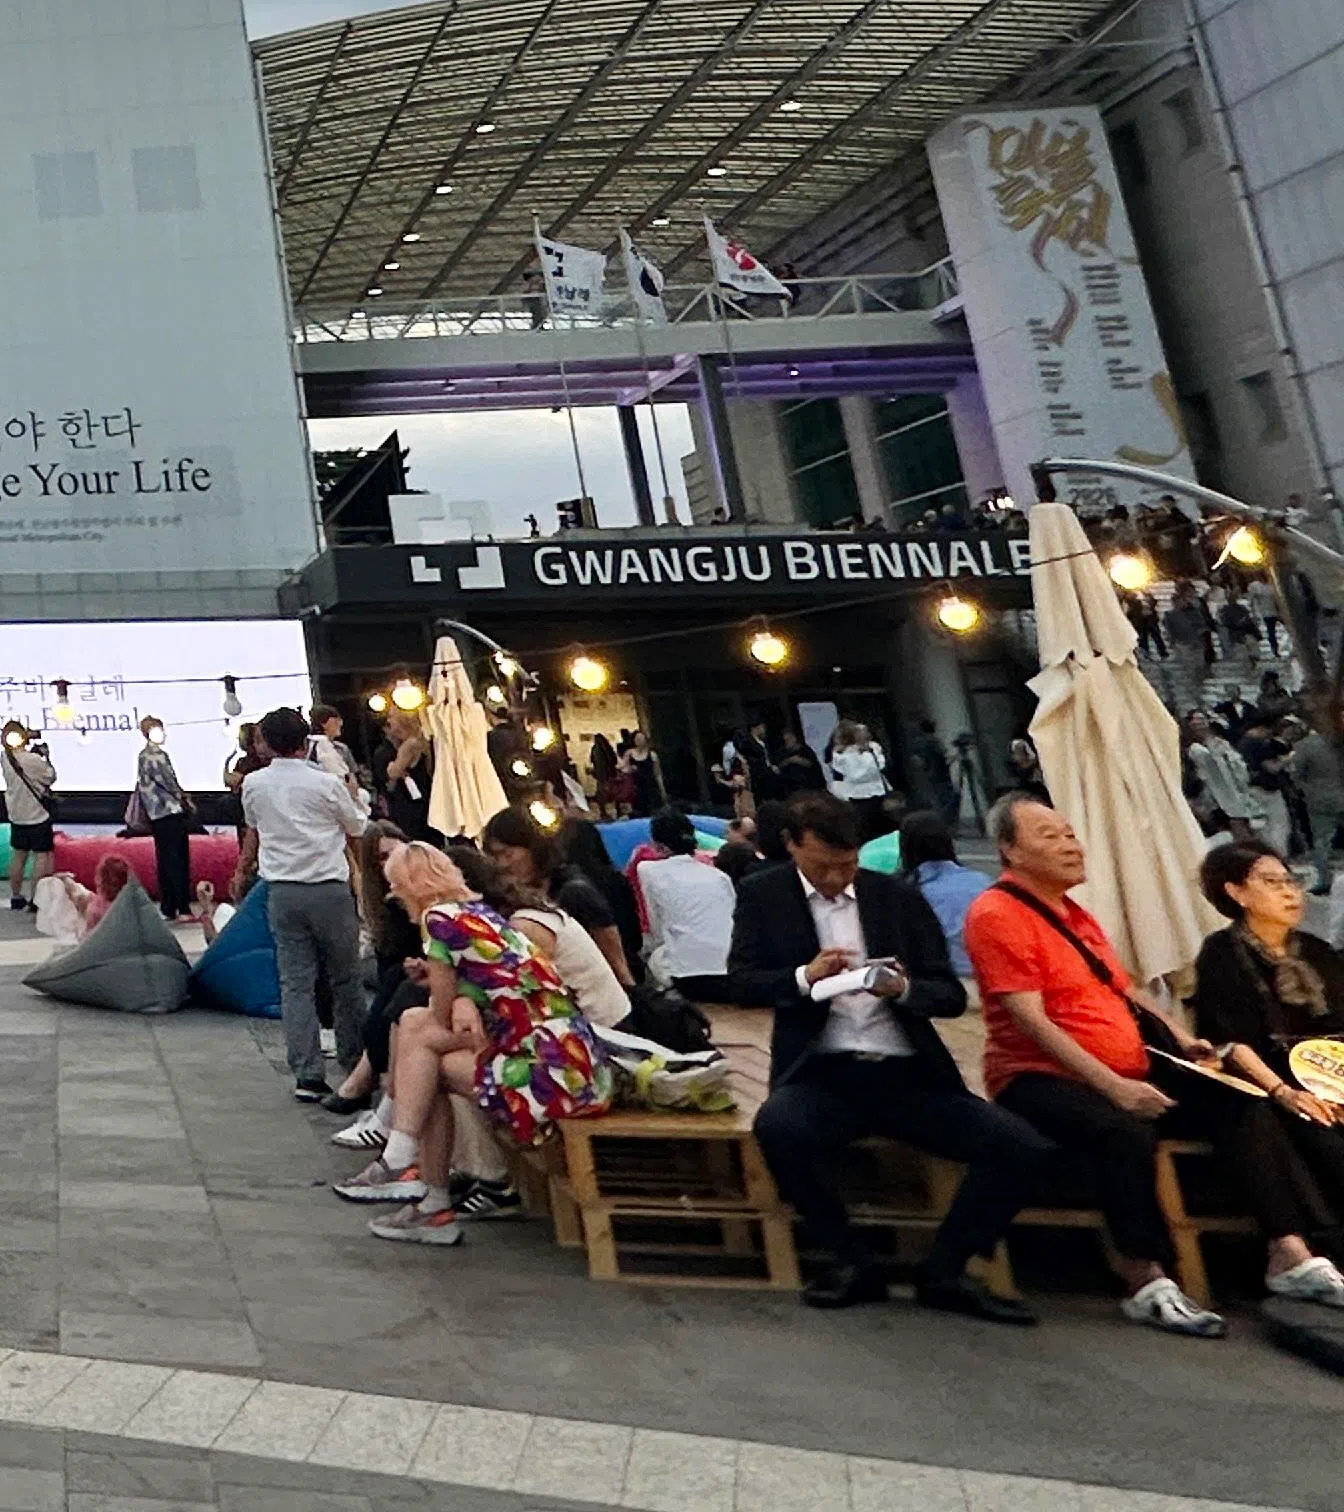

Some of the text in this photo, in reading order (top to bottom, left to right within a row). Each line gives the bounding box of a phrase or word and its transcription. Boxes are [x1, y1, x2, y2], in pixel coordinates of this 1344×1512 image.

[57, 406, 143, 450] 한다
[29, 461, 120, 497] Your
[132, 456, 212, 494] Life
[534, 538, 1031, 586] GWANGJU BIENNALE
[41, 706, 140, 732] Bennal
